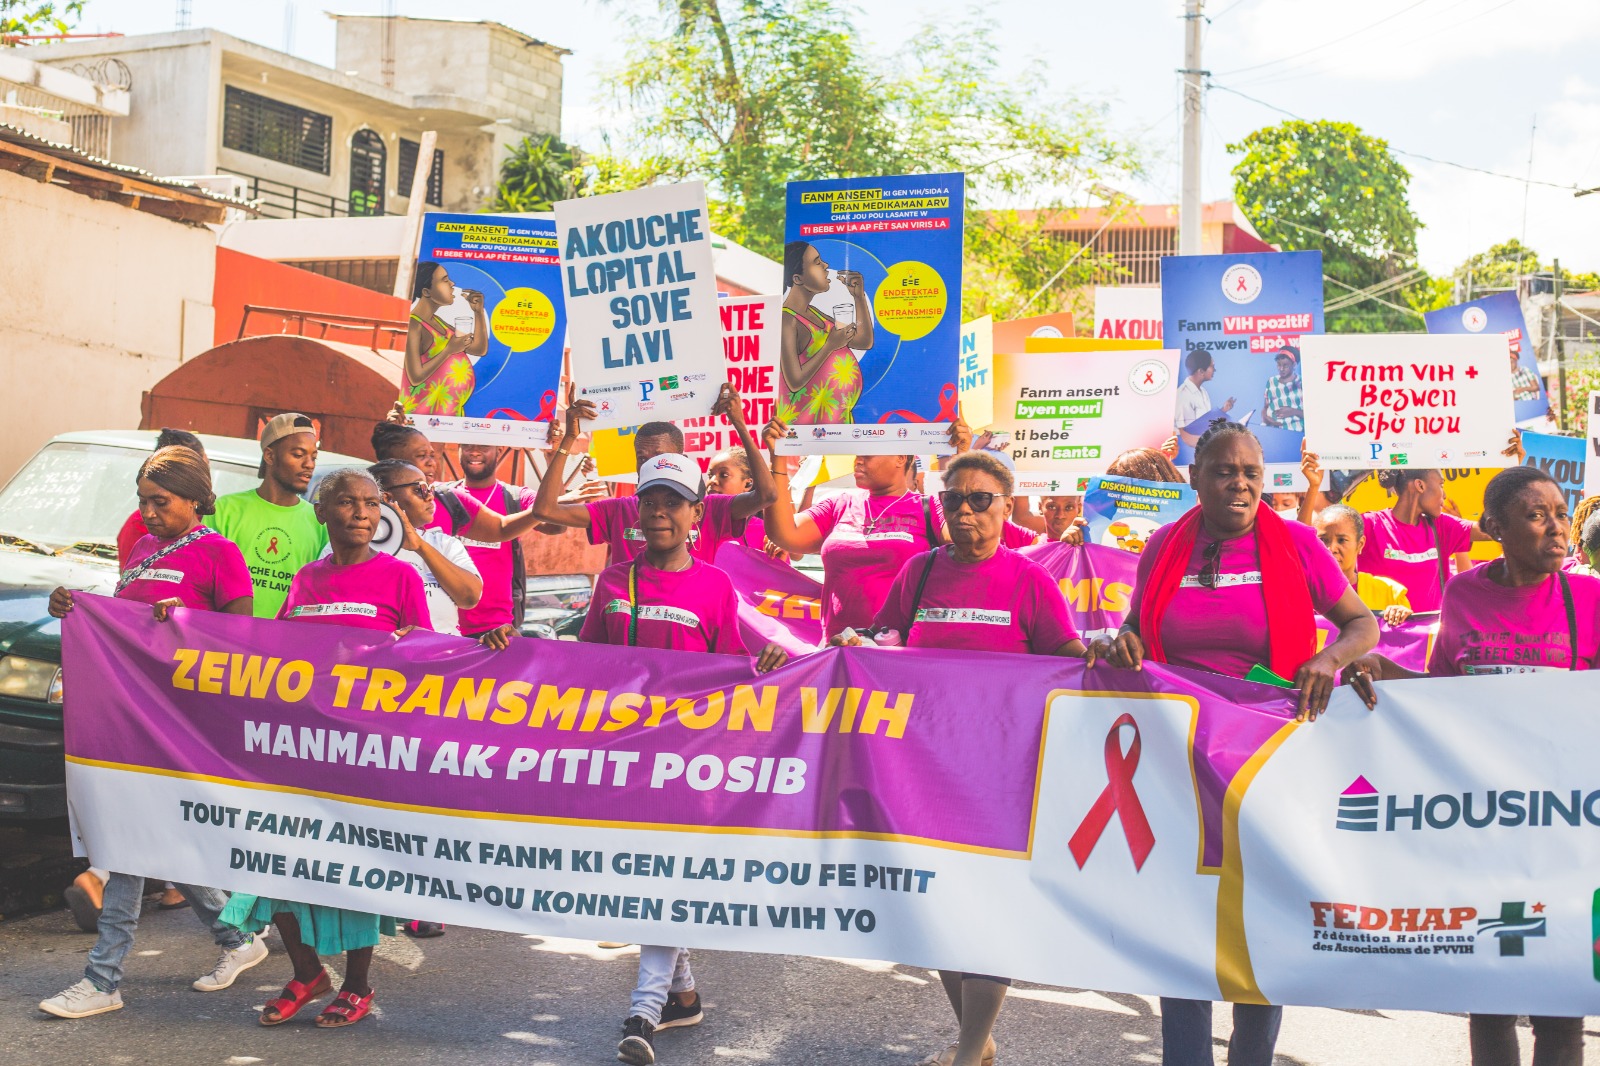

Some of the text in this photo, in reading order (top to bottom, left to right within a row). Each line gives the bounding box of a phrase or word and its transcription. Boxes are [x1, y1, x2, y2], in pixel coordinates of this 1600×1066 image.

[803, 193, 834, 203] FANM
[837, 189, 881, 200] ANSENT
[909, 187, 943, 195] VIH/SIDA
[833, 198, 947, 211] PRAN MEDIKAMAN ARV
[831, 213, 851, 221] CHAK
[851, 212, 867, 220] JOU
[885, 211, 918, 219] LASANTE
[438, 223, 466, 232] FANM
[468, 225, 508, 234] ANSENT
[565, 208, 703, 261] AKOUCHE
[803, 226, 811, 234] TI
[812, 225, 834, 233] BEBE
[836, 224, 845, 232] W
[873, 221, 889, 230] FÈT
[890, 222, 909, 230] SAN
[910, 221, 933, 229] VIRIS
[934, 220, 946, 228] LA
[464, 234, 488, 242] PRAN
[490, 236, 542, 246] MEDIKAMAN
[497, 252, 511, 261] FÈT
[508, 245, 538, 253] LASANTE
[567, 250, 696, 297] LOPITAL
[883, 288, 939, 297] ENDETEKTAB
[500, 309, 549, 318] ENDETEKTAB
[609, 287, 693, 330] SOVE
[879, 308, 943, 317] ENTRANSMISIB
[719, 303, 765, 331] NTE
[1178, 313, 1311, 333] Fanm VIH pozitif
[495, 324, 550, 334] ENTRANSMISIB
[601, 328, 674, 369] LAVI
[723, 335, 760, 362] UN
[1185, 339, 1248, 351] bezwen
[1251, 335, 1286, 353] sipò
[1324, 361, 1404, 382] Fanm
[1410, 363, 1454, 382] VIH
[1020, 385, 1120, 398] Fanm ansent
[1359, 384, 1456, 412] Bezwen
[1017, 402, 1101, 419] byen nouri
[1344, 410, 1461, 440] Sipò nou
[1014, 429, 1069, 441] ti bebe
[1012, 446, 1099, 461] pi an sante
[1100, 481, 1180, 499] DISKRIMINASYON
[1115, 500, 1151, 511] VIH/SIDA
[248, 566, 270, 576] CHE
[1058, 578, 1134, 612] MIS
[1513, 647, 1540, 662] SAN
[172, 648, 916, 740] ZEWO TRANSMISYON VIH
[244, 720, 808, 795] MANMAN AK PITIT POSIB
[179, 800, 936, 894] TOUT FANM ANSENT AK FANM KI GEN LAJ POU FE PITIT
[229, 847, 877, 933] DWE ALE LOPITAL POU KONNEN STATI VIH YO
[1309, 901, 1478, 932] FEDHAP
[1313, 930, 1475, 943] Fédération Haïtienne
[1312, 942, 1474, 955] des Associations de PVVIH
